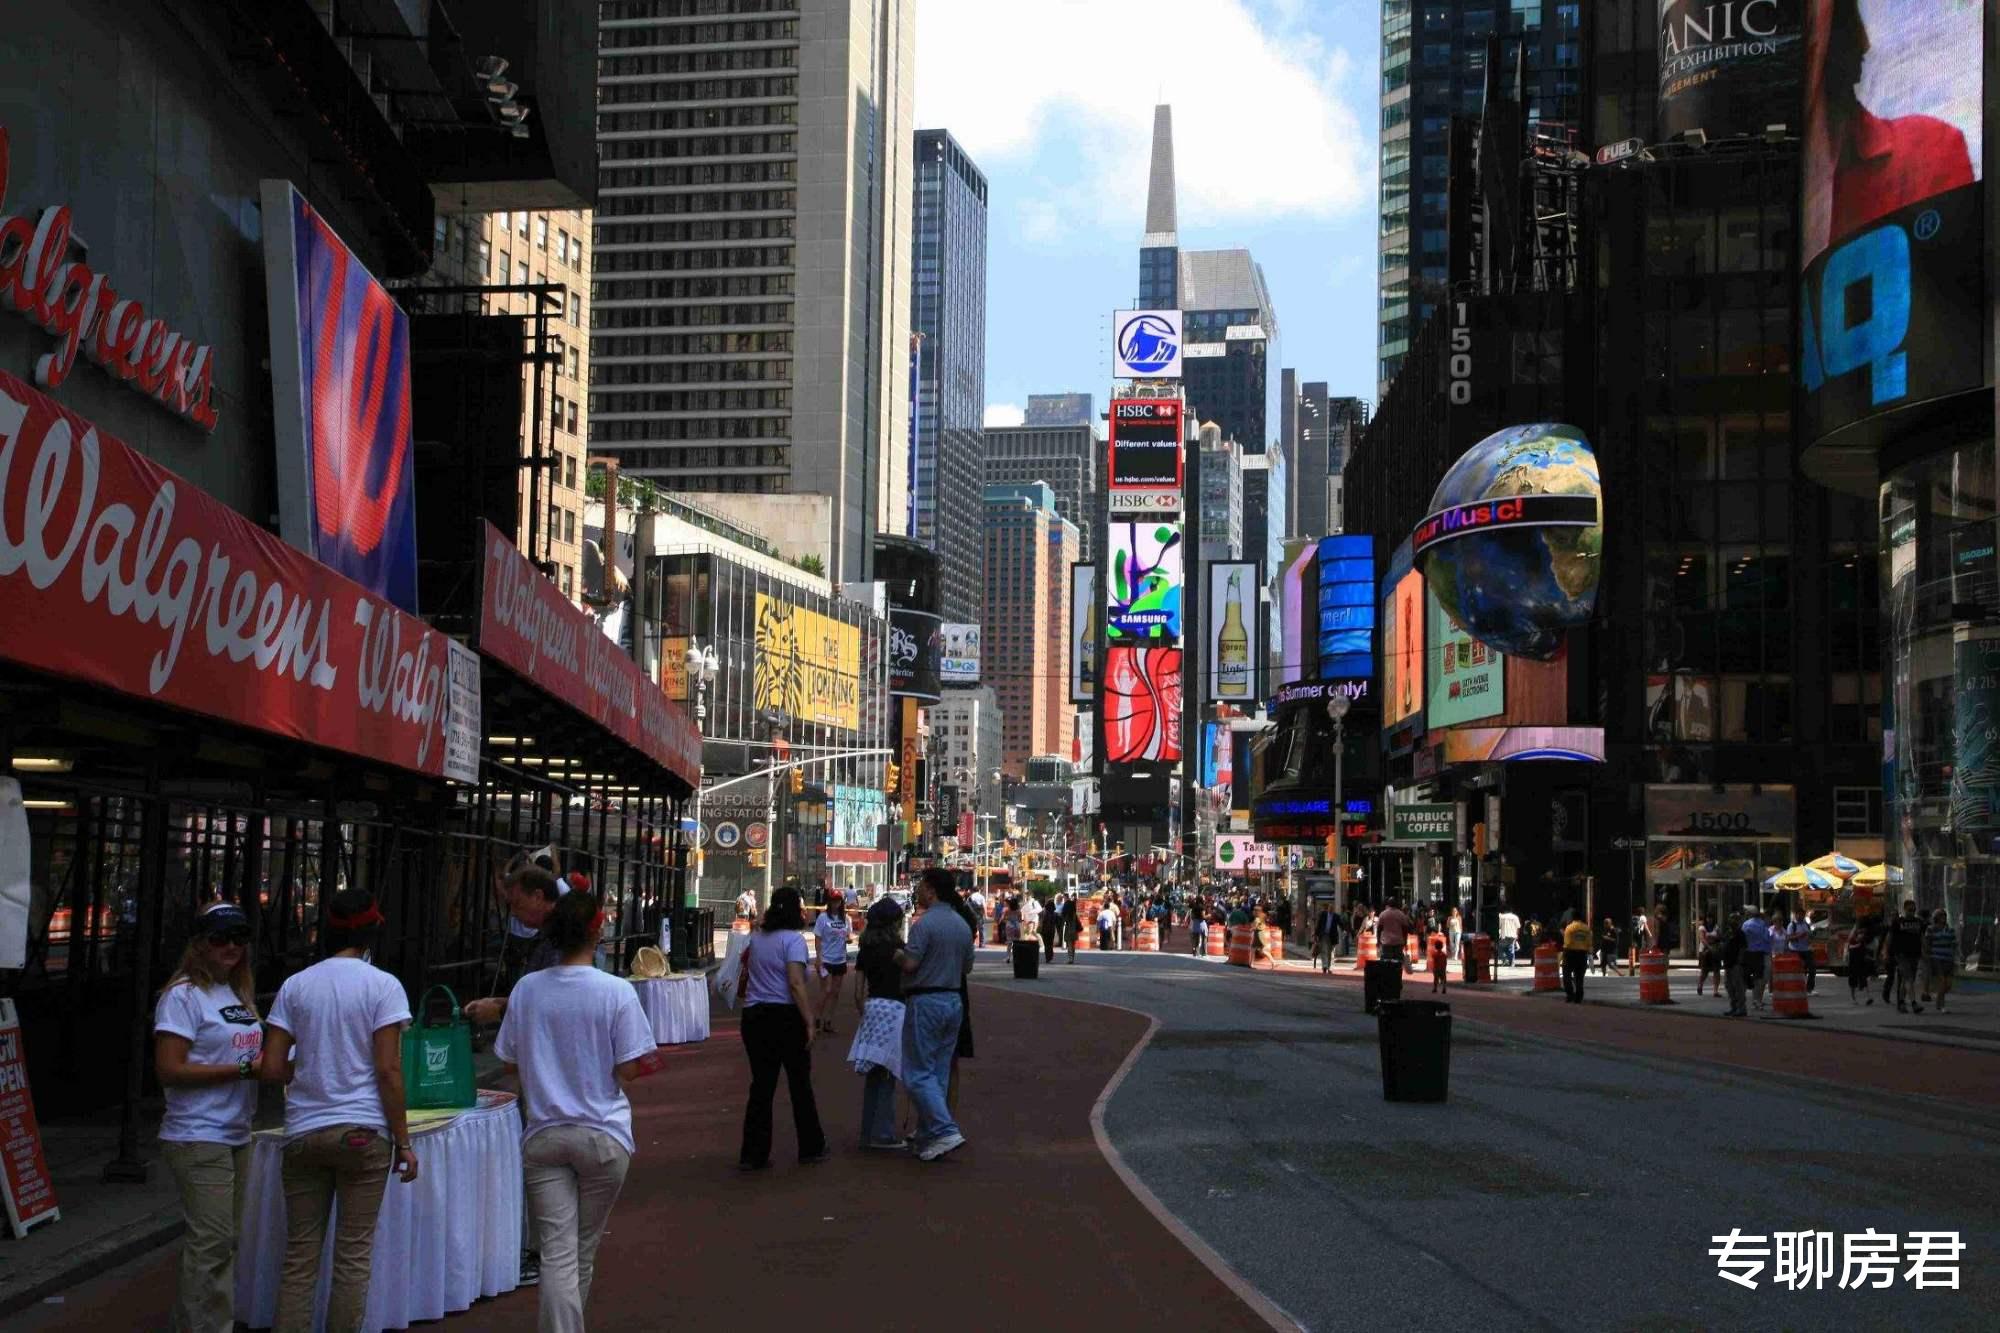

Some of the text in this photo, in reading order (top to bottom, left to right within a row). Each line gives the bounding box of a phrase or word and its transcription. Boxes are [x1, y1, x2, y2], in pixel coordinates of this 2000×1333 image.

[1680, 40, 1777, 71] EXHIBITION
[1603, 141, 1633, 161] FUEL
[1449, 302, 1472, 405] 1500
[1117, 405, 1152, 417] HSBC
[1115, 440, 1177, 448] Different values
[1113, 495, 1153, 507] HSBC
[1443, 498, 1524, 531] Music!
[493, 538, 579, 676] Walgreens
[1121, 614, 1168, 624] SAMSUNG
[666, 648, 681, 660] THE
[823, 636, 838, 658] THE
[806, 659, 854, 710] LION KING
[1286, 685, 1325, 701] Summer
[902, 738, 916, 804] Kodak
[1407, 822, 1450, 833] COFFEE
[1688, 812, 1750, 832] 1500
[1243, 842, 1264, 851] Take
